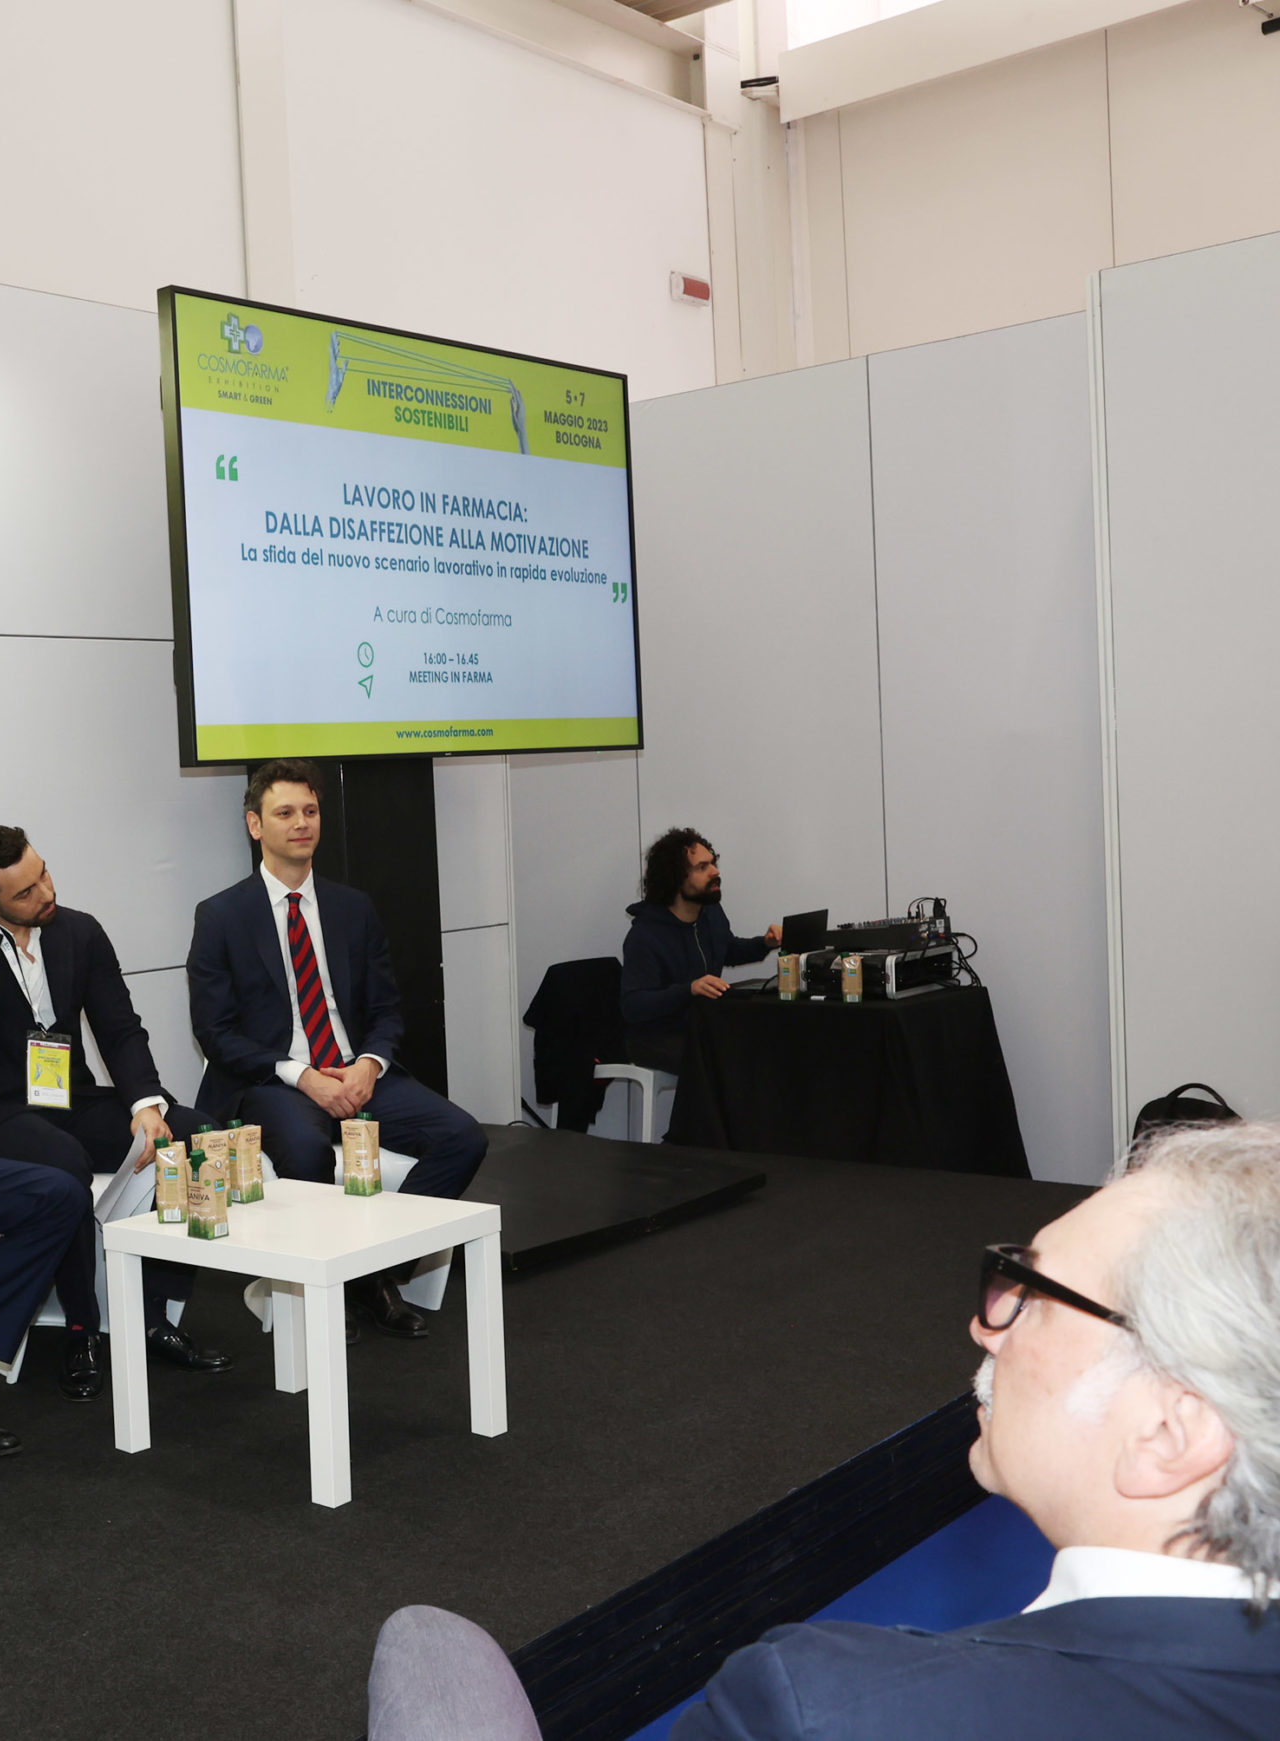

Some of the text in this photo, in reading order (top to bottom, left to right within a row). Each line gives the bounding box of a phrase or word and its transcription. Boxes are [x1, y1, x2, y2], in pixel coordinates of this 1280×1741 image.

[197, 353, 288, 383] COSMOFARMA
[218, 390, 241, 401] SMART
[249, 395, 273, 406] GREEN
[367, 378, 492, 415] INTERCONNESSIONI
[394, 406, 469, 433] SOSTENIBILI
[544, 409, 609, 433] MAGGIO 2023
[555, 430, 602, 450] BOLOGNA
[343, 483, 528, 523] LAVORO IN FARMACIA:
[265, 510, 589, 559] DALLA DISAFFEZIONE ALLA MOTIVAZIONE
[241, 543, 608, 585] La sfida del nuovo scenario lavorativo in rapida evoluzione
[373, 605, 512, 627] A cura di Cosmofarma
[424, 653, 447, 665] 16:00
[456, 653, 479, 665] 16.45
[409, 671, 493, 683] MEETING IN FARMA
[396, 726, 494, 738] www.cosmofarma.com
